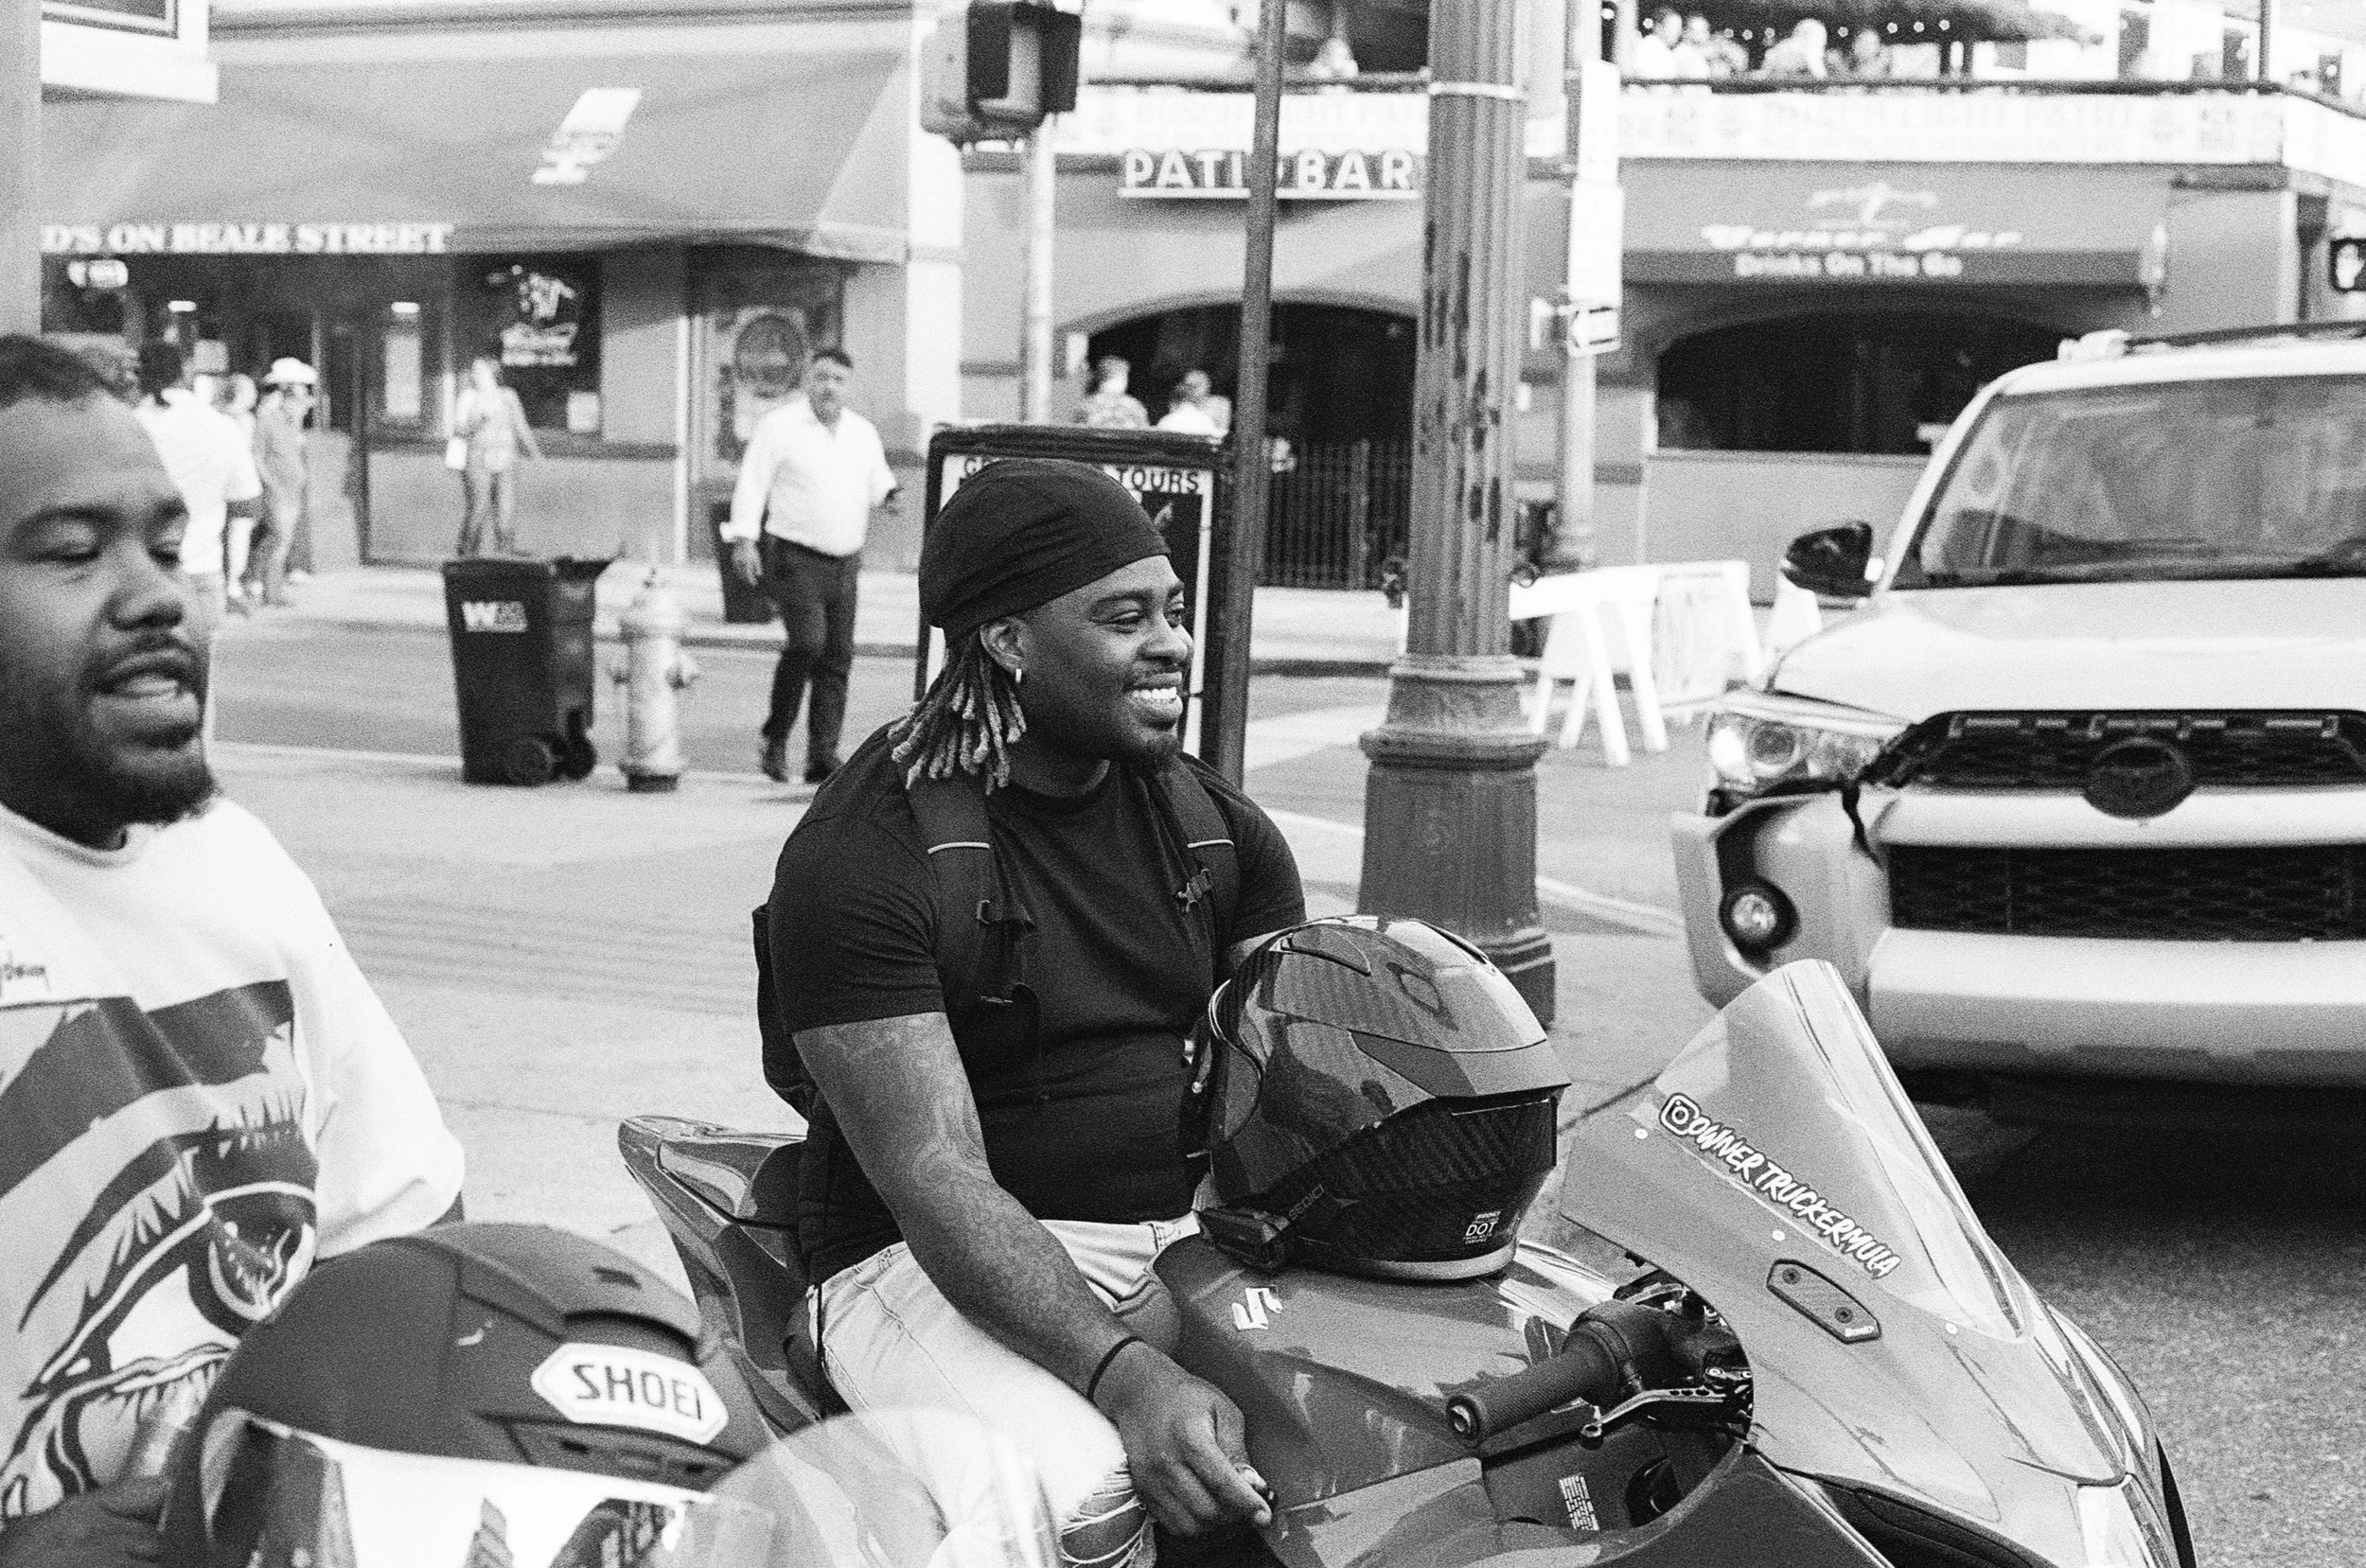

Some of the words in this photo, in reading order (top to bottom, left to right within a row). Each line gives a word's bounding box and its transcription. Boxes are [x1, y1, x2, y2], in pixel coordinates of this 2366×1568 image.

[1125, 150, 1282, 188] PATI
[1297, 150, 1415, 189] BAR
[108, 224, 165, 253] ON
[171, 224, 288, 253] BEALE
[295, 223, 451, 254] STREET
[1116, 467, 1199, 493] TOURS
[1686, 1116, 1765, 1183] OWNER
[1465, 1221, 1498, 1237] DOT
[572, 1364, 702, 1421] SHOEI
